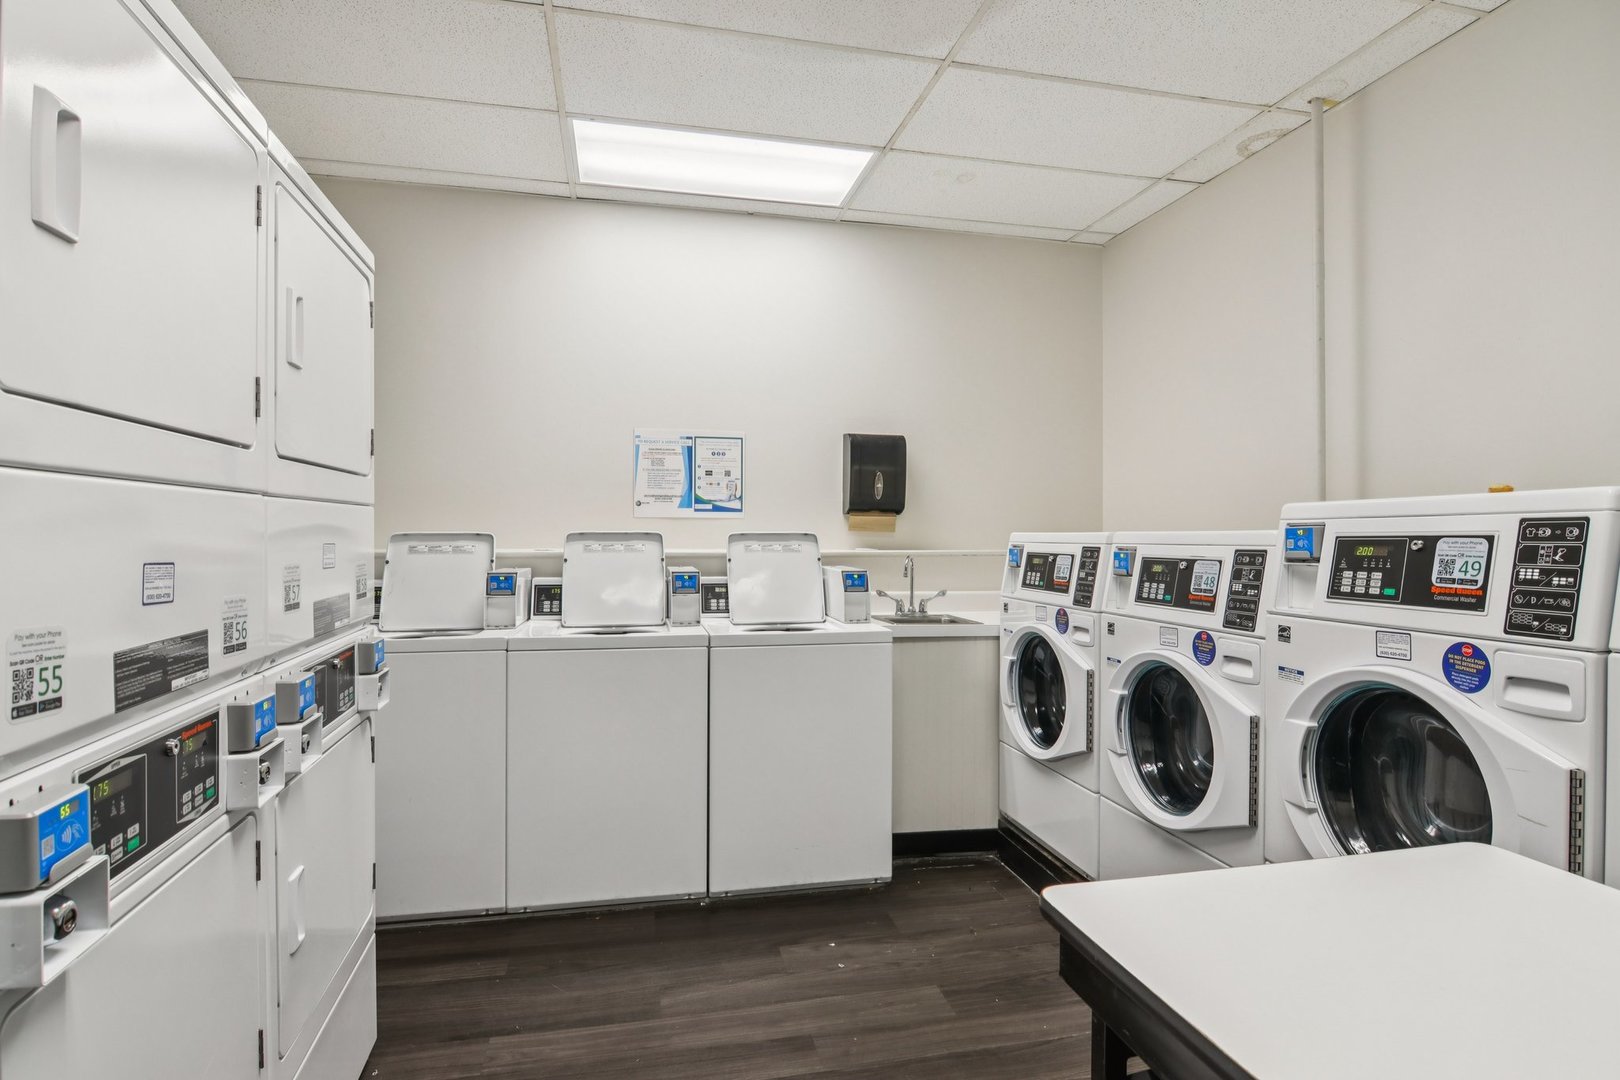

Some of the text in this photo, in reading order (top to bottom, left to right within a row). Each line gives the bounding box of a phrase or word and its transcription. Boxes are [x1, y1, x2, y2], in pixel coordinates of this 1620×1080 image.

[1458, 560, 1482, 577] 49
[1203, 576, 1216, 588] 48
[291, 584, 300, 601] 57
[1431, 586, 1456, 594] Speed
[1434, 594, 1459, 602] Commercial
[235, 620, 248, 641] 56
[35, 654, 44, 663] OR
[1455, 665, 1477, 673] DISPENSER
[1461, 661, 1484, 670] DETERGENT
[38, 664, 63, 697] 55
[60, 803, 71, 819] 55
